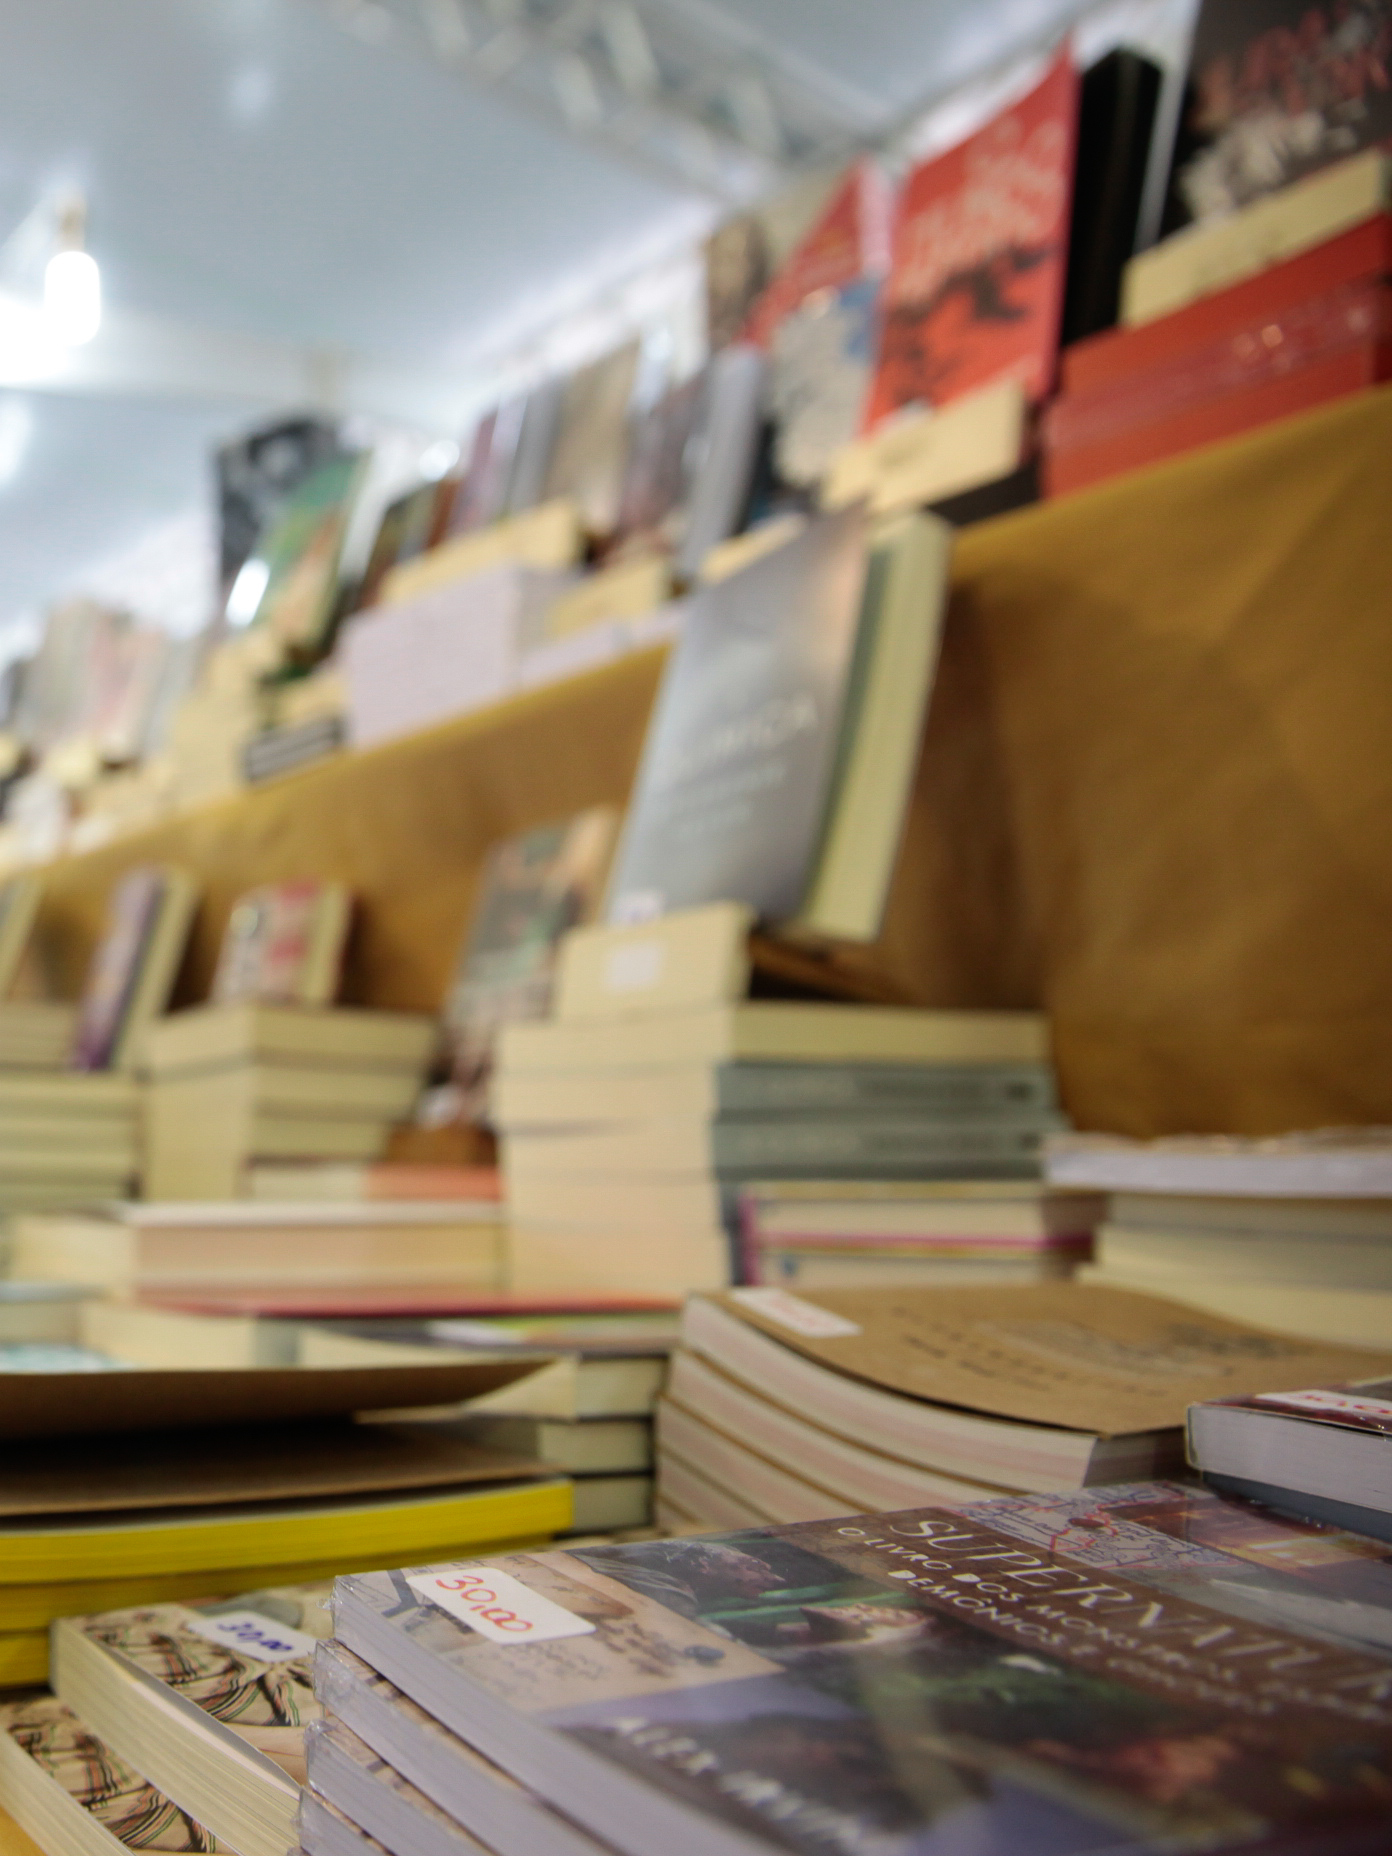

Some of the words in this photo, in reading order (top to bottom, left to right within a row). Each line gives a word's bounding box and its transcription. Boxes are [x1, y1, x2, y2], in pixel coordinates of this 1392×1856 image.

[837, 1527, 866, 1537] O
[863, 1538, 953, 1571] LIVRO
[952, 1572, 1024, 1602] DOS
[435, 1575, 534, 1632] 30,00
